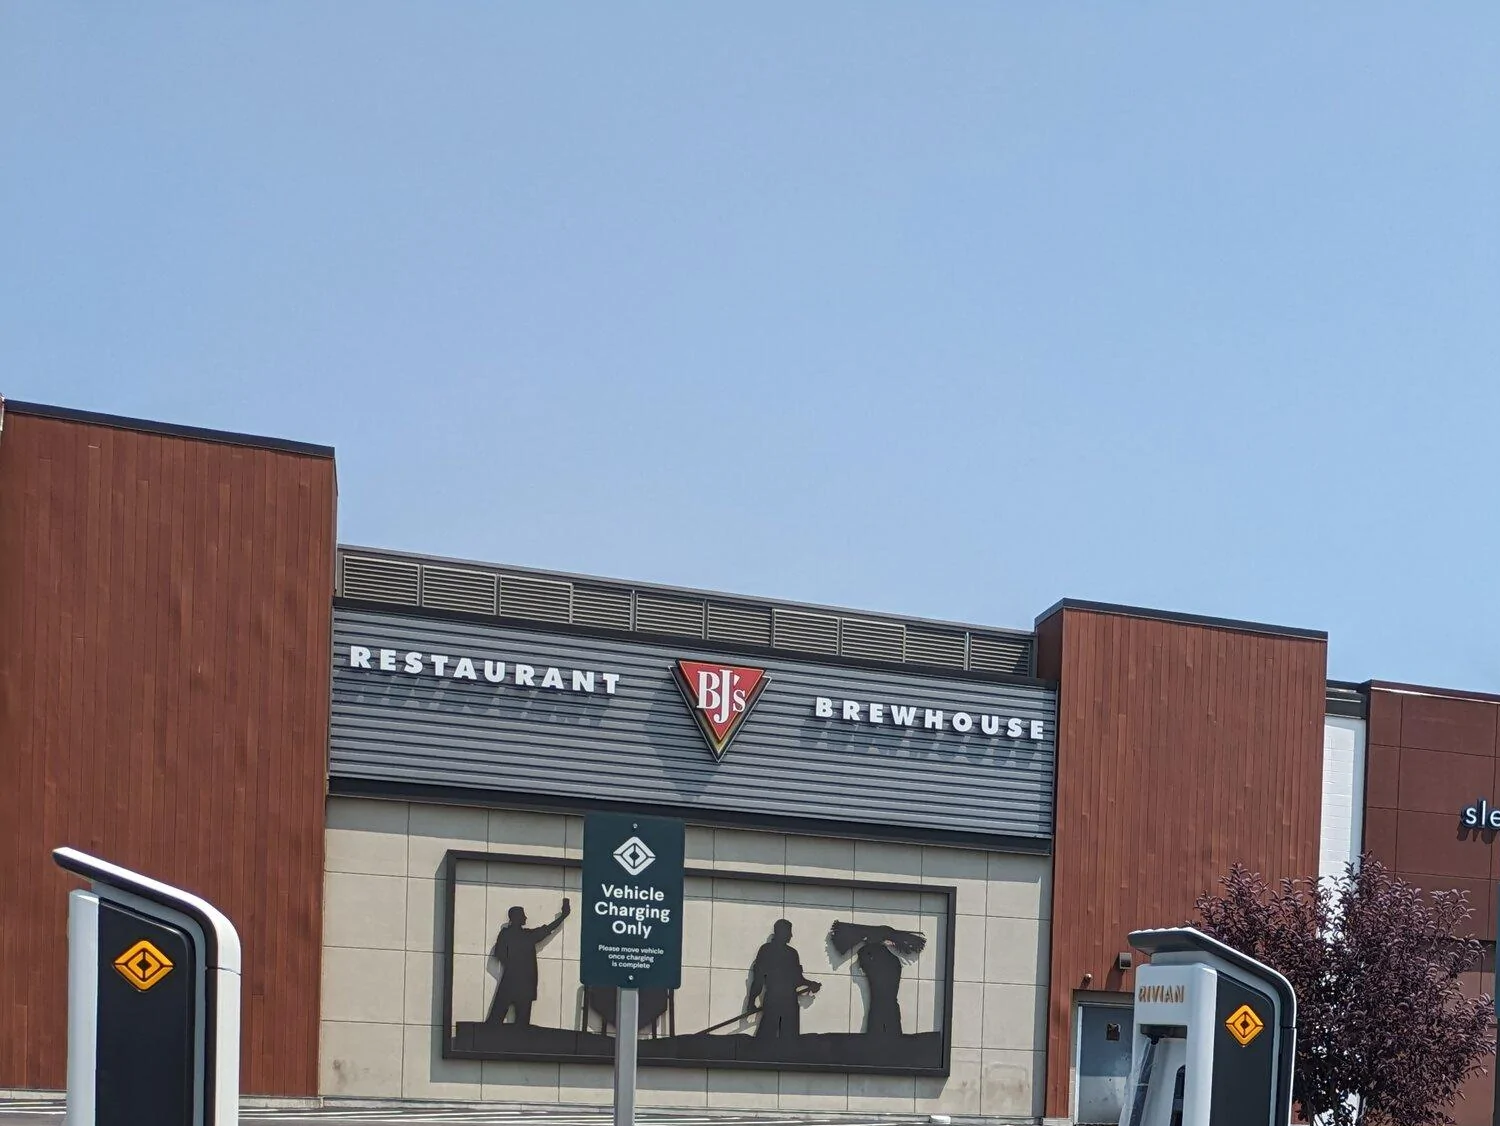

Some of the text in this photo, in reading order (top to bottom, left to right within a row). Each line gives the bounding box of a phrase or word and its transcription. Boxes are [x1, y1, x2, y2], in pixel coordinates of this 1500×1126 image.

[350, 645, 620, 694] RESTAURANT
[696, 669, 746, 724] BJ's
[815, 697, 1044, 740] BREWHOUSE
[601, 883, 665, 901] Vehicle
[594, 901, 671, 923] Charging
[612, 920, 652, 939] Only
[598, 944, 665, 955] Please move vehicle
[626, 953, 655, 962] charging
[1138, 985, 1185, 1003] RIVIAN
